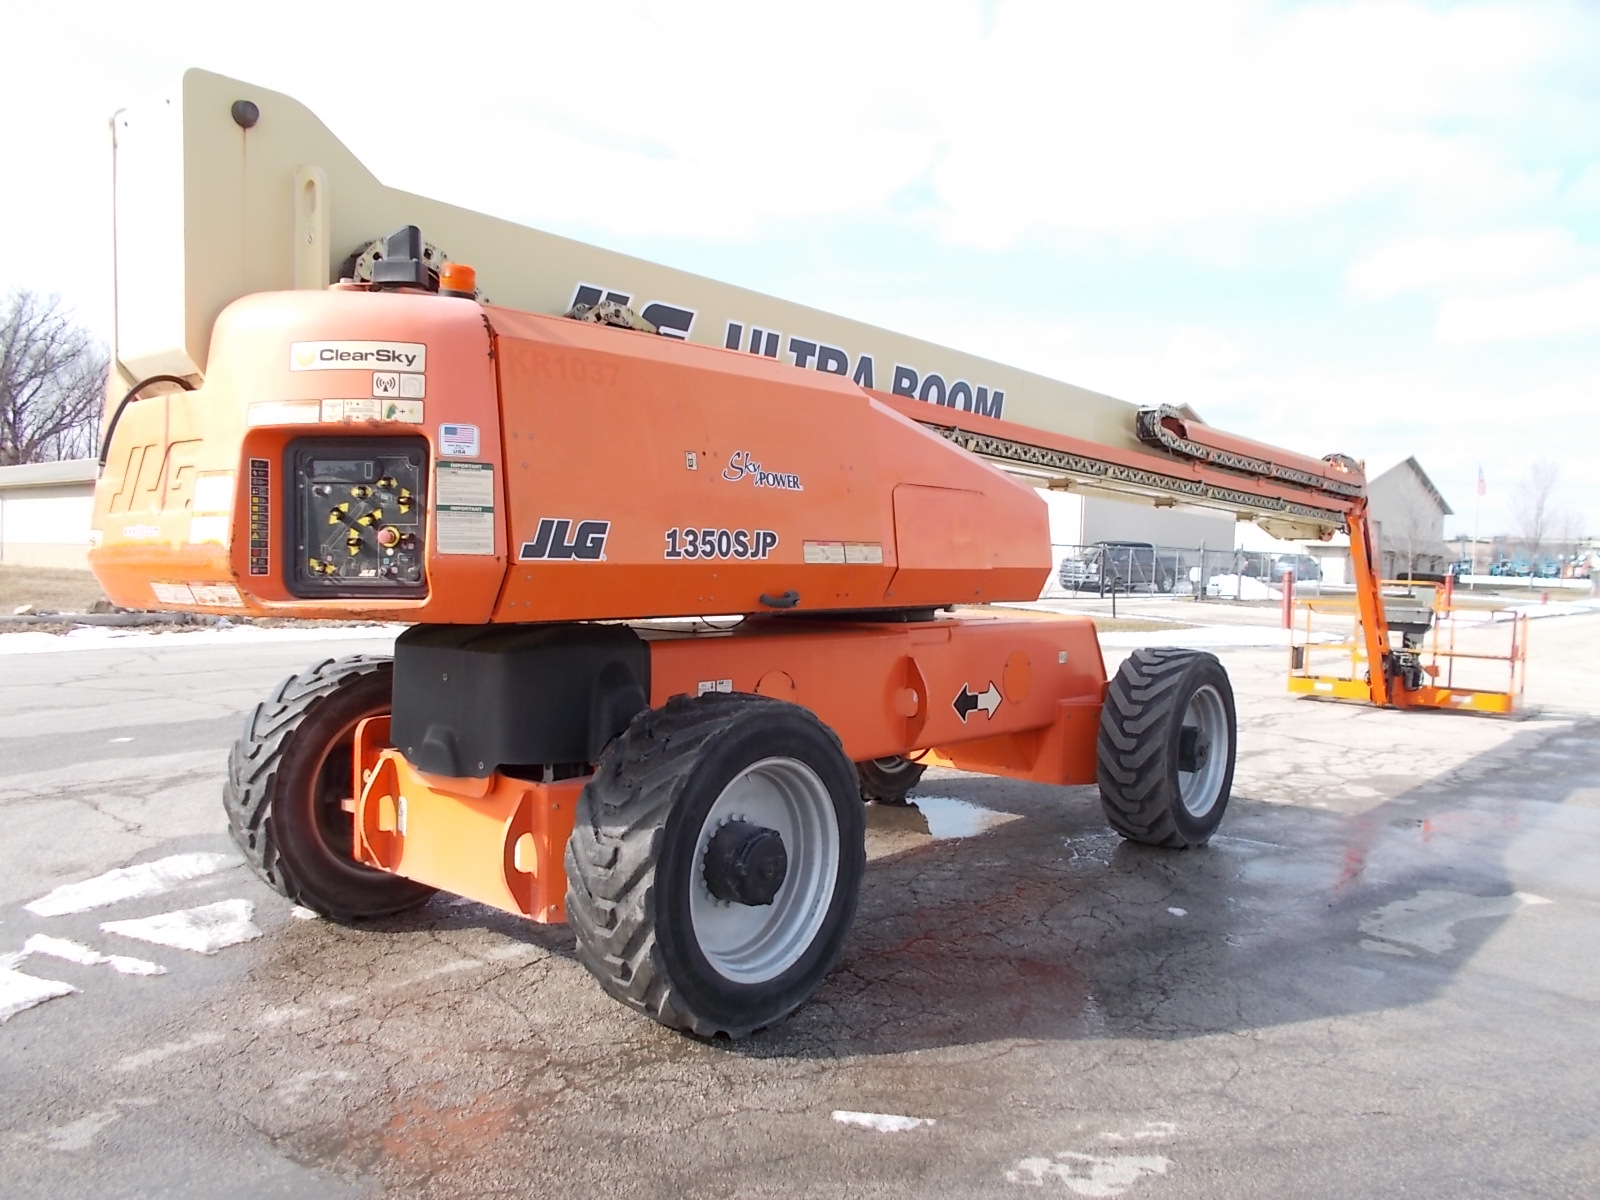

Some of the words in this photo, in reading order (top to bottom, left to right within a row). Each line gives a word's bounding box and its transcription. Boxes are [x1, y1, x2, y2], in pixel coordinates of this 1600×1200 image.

[319, 349, 417, 367] ClearSky
[722, 451, 761, 486] Sky
[760, 472, 801, 489] POWER
[519, 518, 611, 560] JLG
[664, 527, 779, 560] 1350SJP
